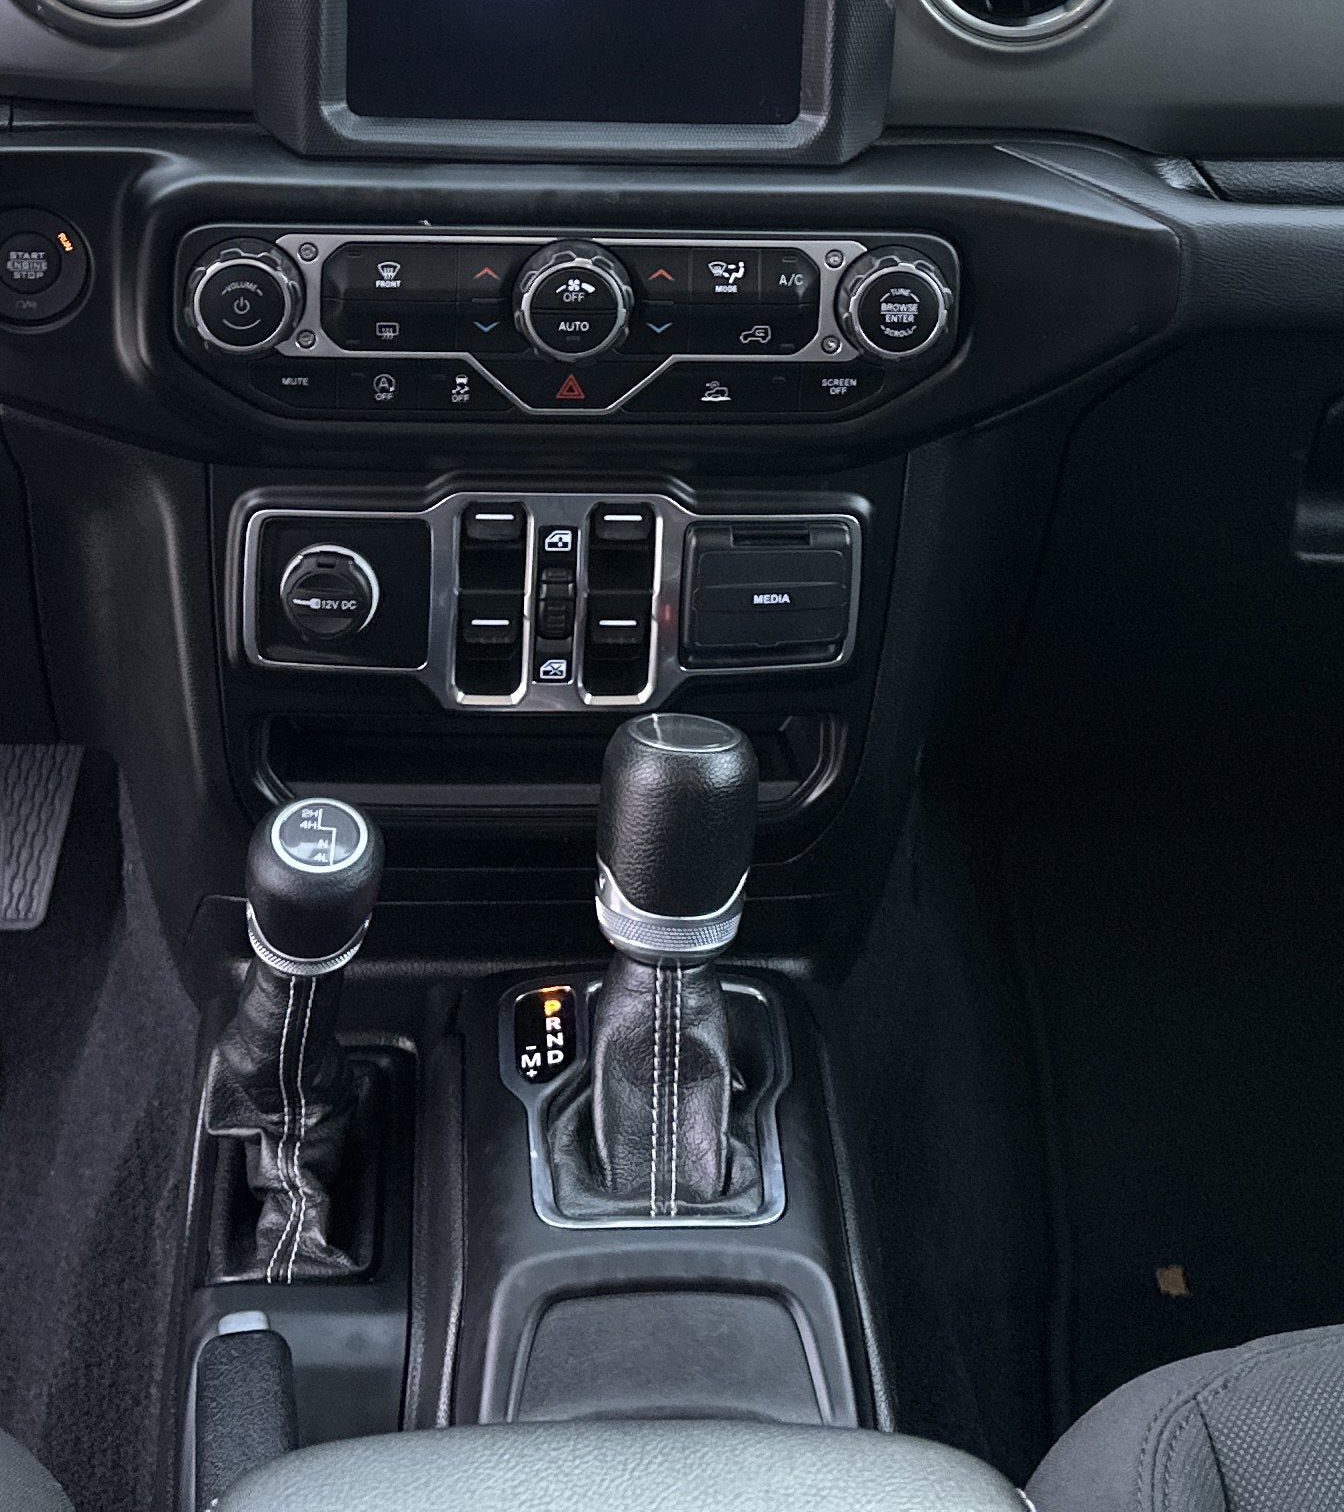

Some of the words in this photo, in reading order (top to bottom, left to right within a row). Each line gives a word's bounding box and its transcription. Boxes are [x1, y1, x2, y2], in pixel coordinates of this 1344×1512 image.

[9, 251, 45, 259] START
[6, 261, 48, 271] ENGINE
[375, 280, 401, 288] FRONT
[779, 273, 804, 287] A/C
[226, 281, 258, 292] VOLUME
[715, 285, 738, 293] MODE
[563, 292, 584, 303] OFF
[880, 303, 918, 312] BROWSE
[885, 314, 915, 323] ENTER
[558, 321, 589, 332] AUTO
[884, 328, 913, 338] SCROLL
[282, 377, 309, 386] MUTE
[822, 378, 856, 387] SCREEN
[830, 387, 847, 395] OFF
[375, 393, 393, 401] OFF
[452, 394, 470, 403] OFF
[320, 598, 341, 610] 12V
[342, 599, 358, 610] DC
[752, 593, 791, 605] MEDIA
[302, 808, 318, 818] 2H
[299, 821, 316, 830] 4H
[317, 839, 329, 849] N
[313, 853, 329, 863] 4L
[544, 999, 561, 1016] P
[546, 1017, 561, 1030] R
[547, 1033, 563, 1048] N
[521, 1053, 541, 1068] M
[547, 1050, 564, 1065] D
